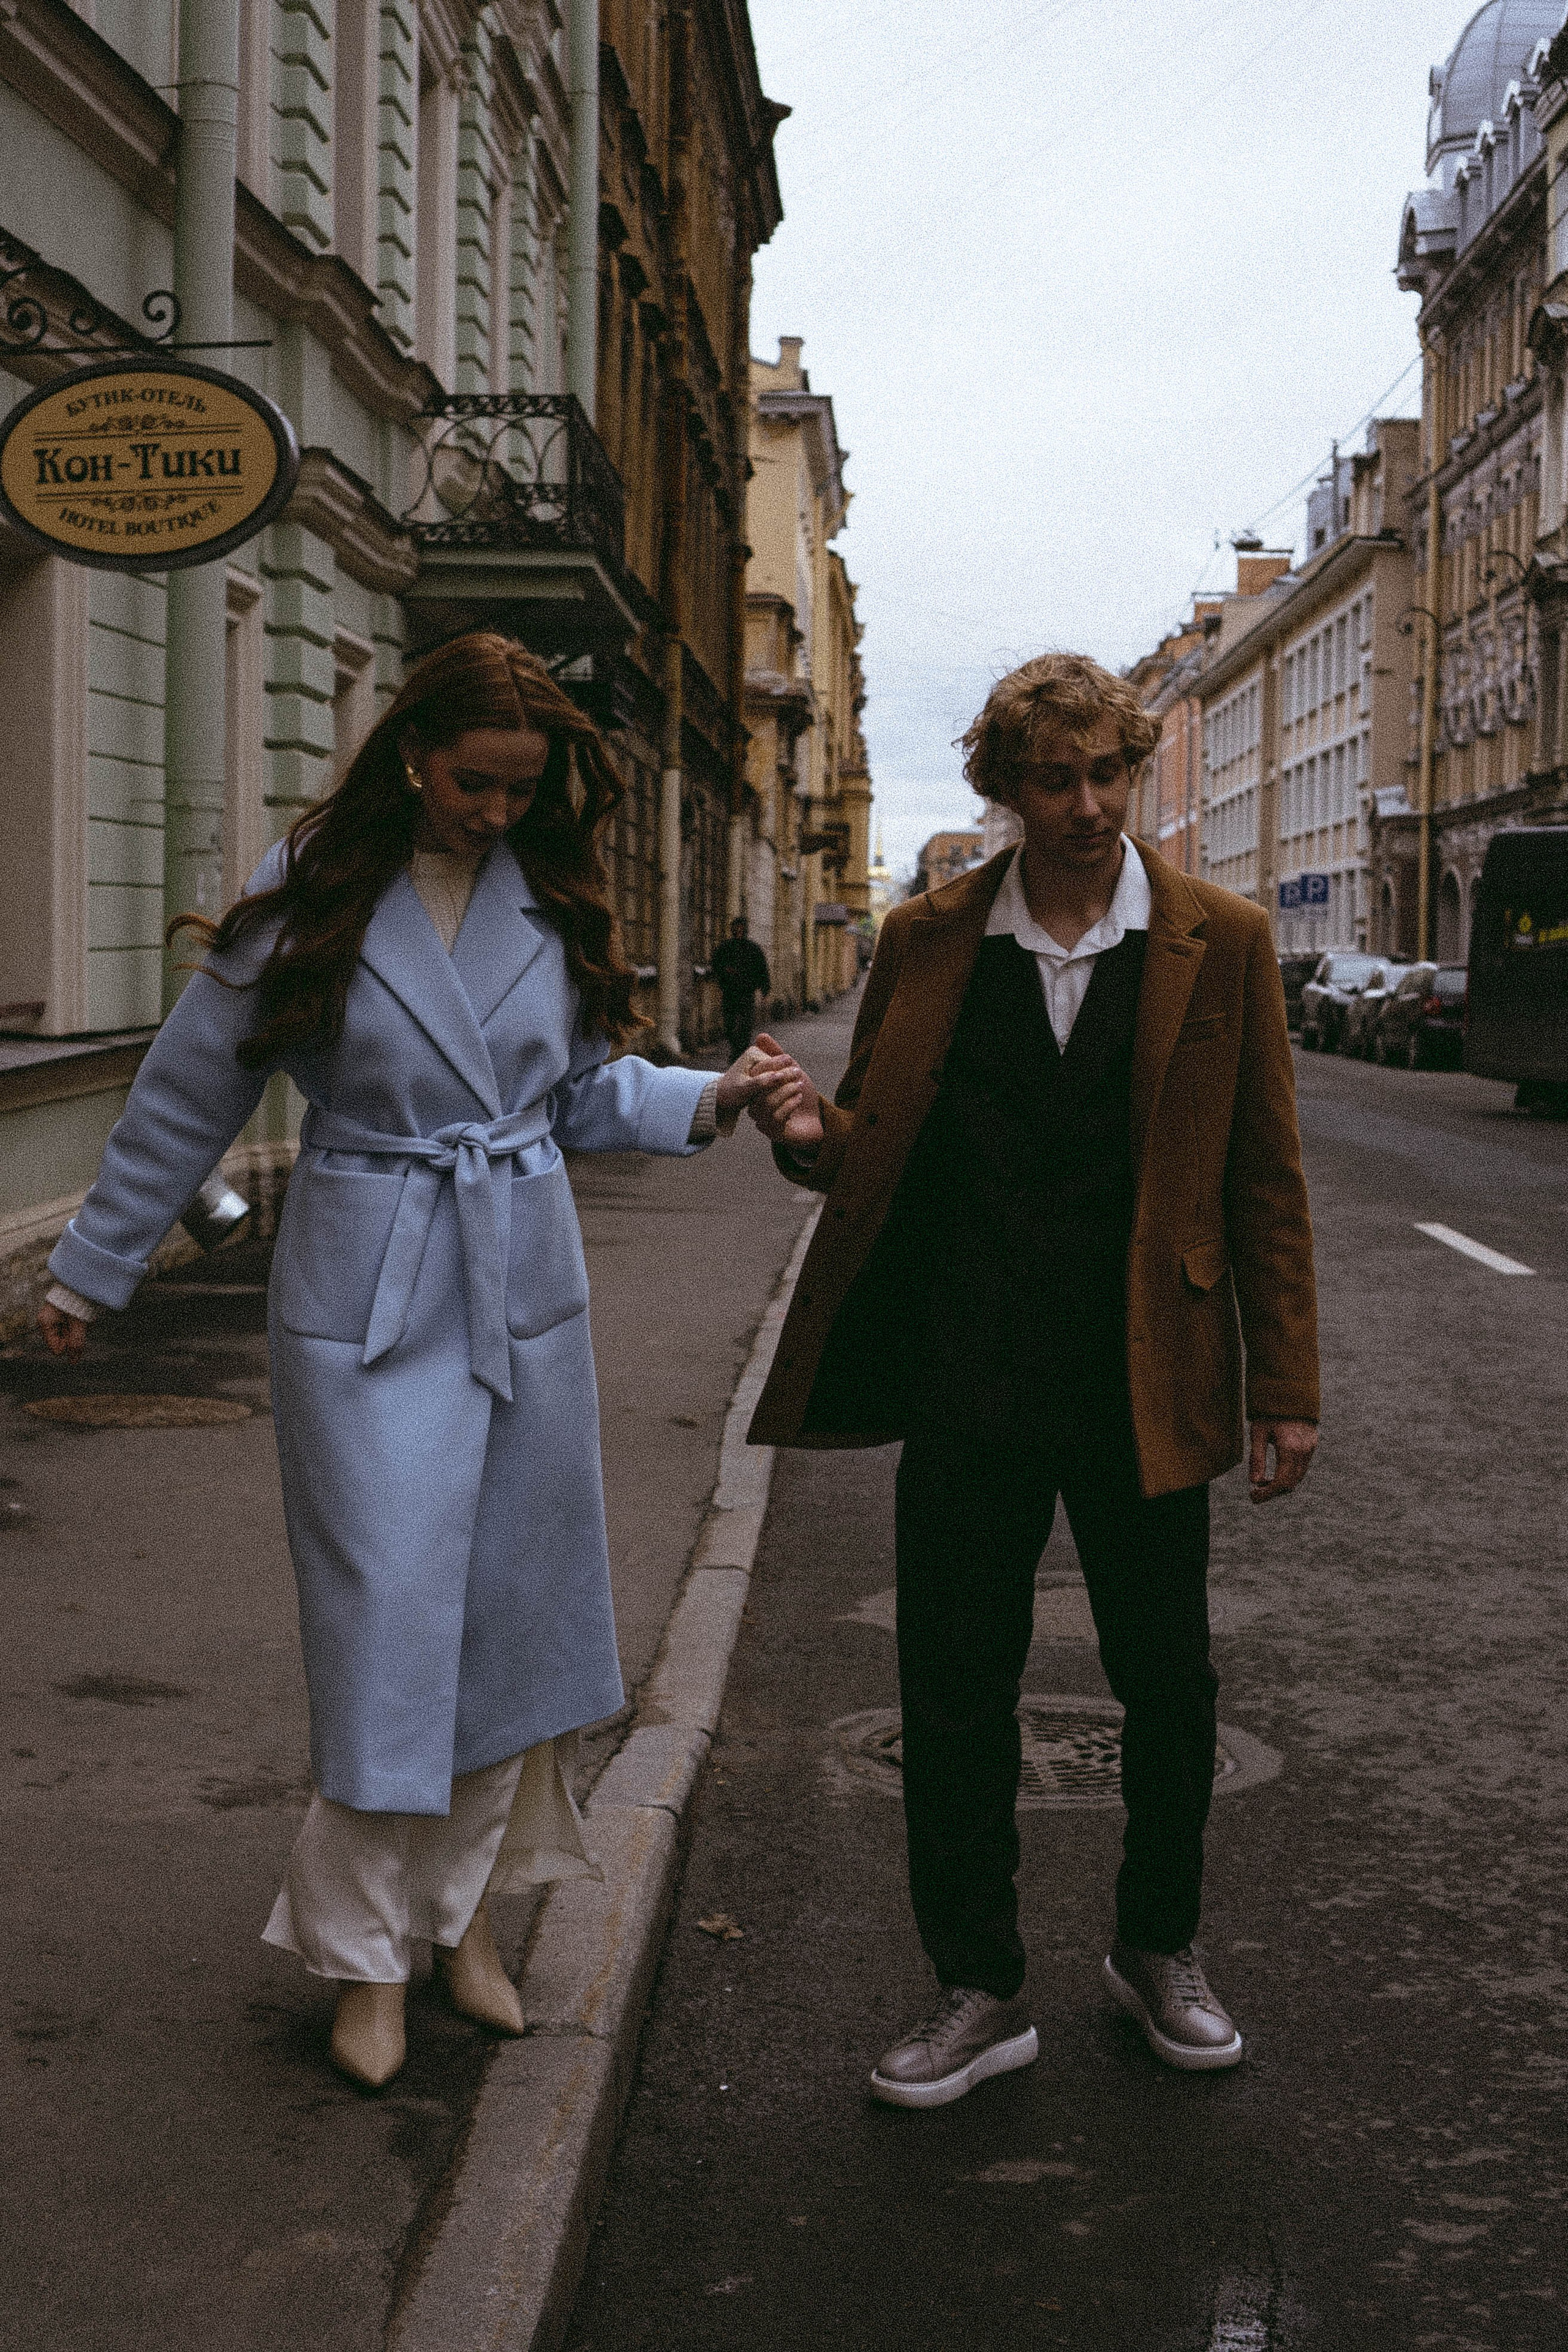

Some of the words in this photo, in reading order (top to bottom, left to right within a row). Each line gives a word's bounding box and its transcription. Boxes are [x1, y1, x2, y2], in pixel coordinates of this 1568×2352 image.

[67, 388, 206, 417] БУТИК-ОТЕЛЬ
[34, 443, 241, 484] Кон-Тики
[59, 507, 121, 536] HOTEL
[125, 501, 221, 536] BOUTIQUE
[1307, 876, 1324, 901] P
